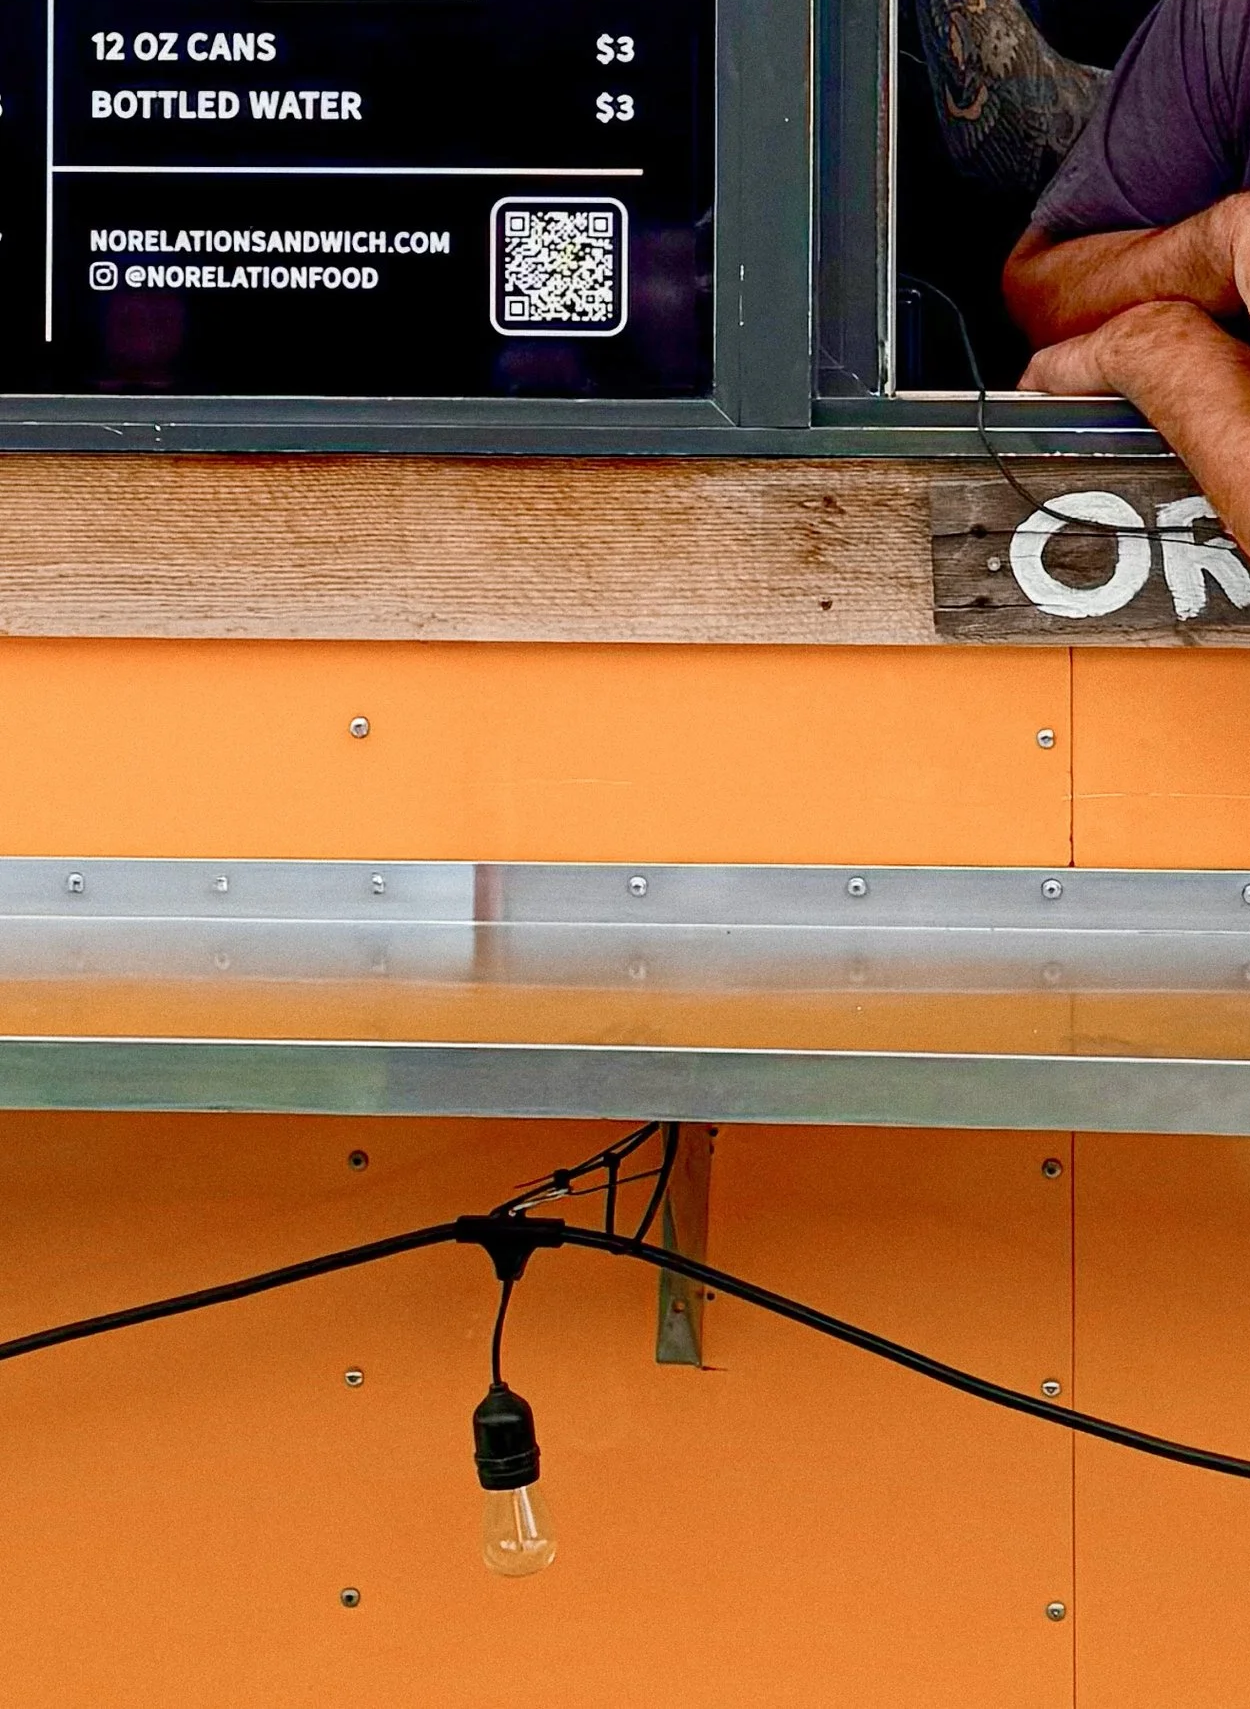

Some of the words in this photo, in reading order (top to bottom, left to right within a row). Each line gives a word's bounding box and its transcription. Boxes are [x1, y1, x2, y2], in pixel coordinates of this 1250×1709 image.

[91, 32, 126, 62] 12
[134, 32, 180, 62] OZ
[187, 32, 278, 63] CANS
[596, 33, 636, 66] $3
[91, 91, 241, 120] BOTTLED
[249, 91, 363, 121] WATER
[596, 92, 636, 125] $3
[90, 229, 451, 255] NORELATIONSANDWICH.COM
[124, 265, 380, 291] @NORELATIONFOOD
